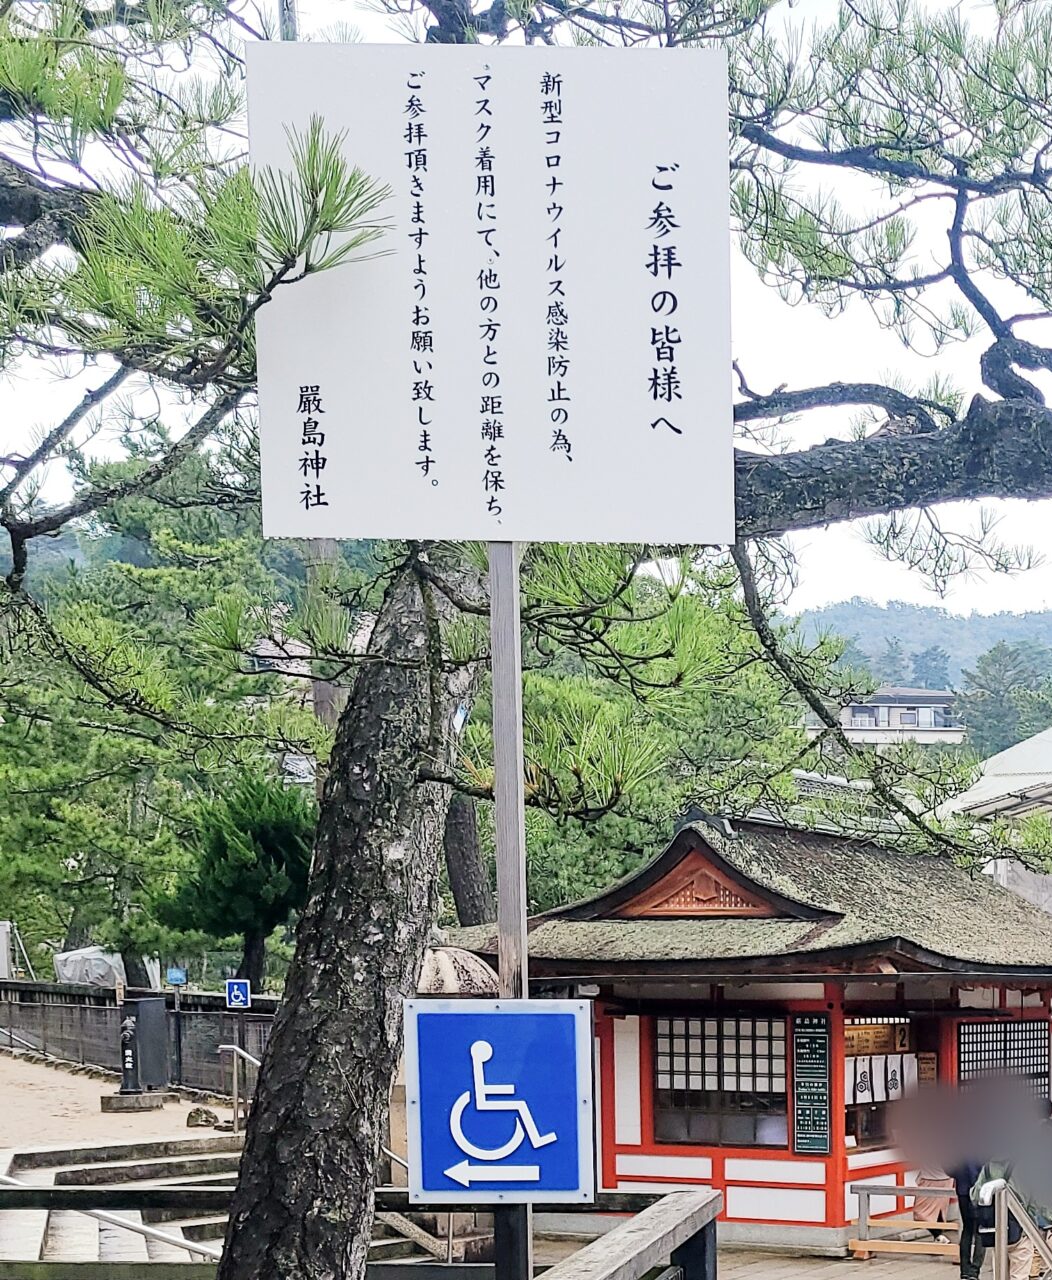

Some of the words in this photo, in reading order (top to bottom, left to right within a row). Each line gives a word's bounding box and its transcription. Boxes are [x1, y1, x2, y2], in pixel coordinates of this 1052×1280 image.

[403, 71, 439, 487] ご参拝頂きますようお願い致します。
[539, 71, 573, 462] 新型コロナウイルス感染防止の為、
[644, 163, 683, 435] ご参拝の皆様へ
[296, 384, 329, 511] 嚴島神社
[899, 1027, 906, 1048] 2
